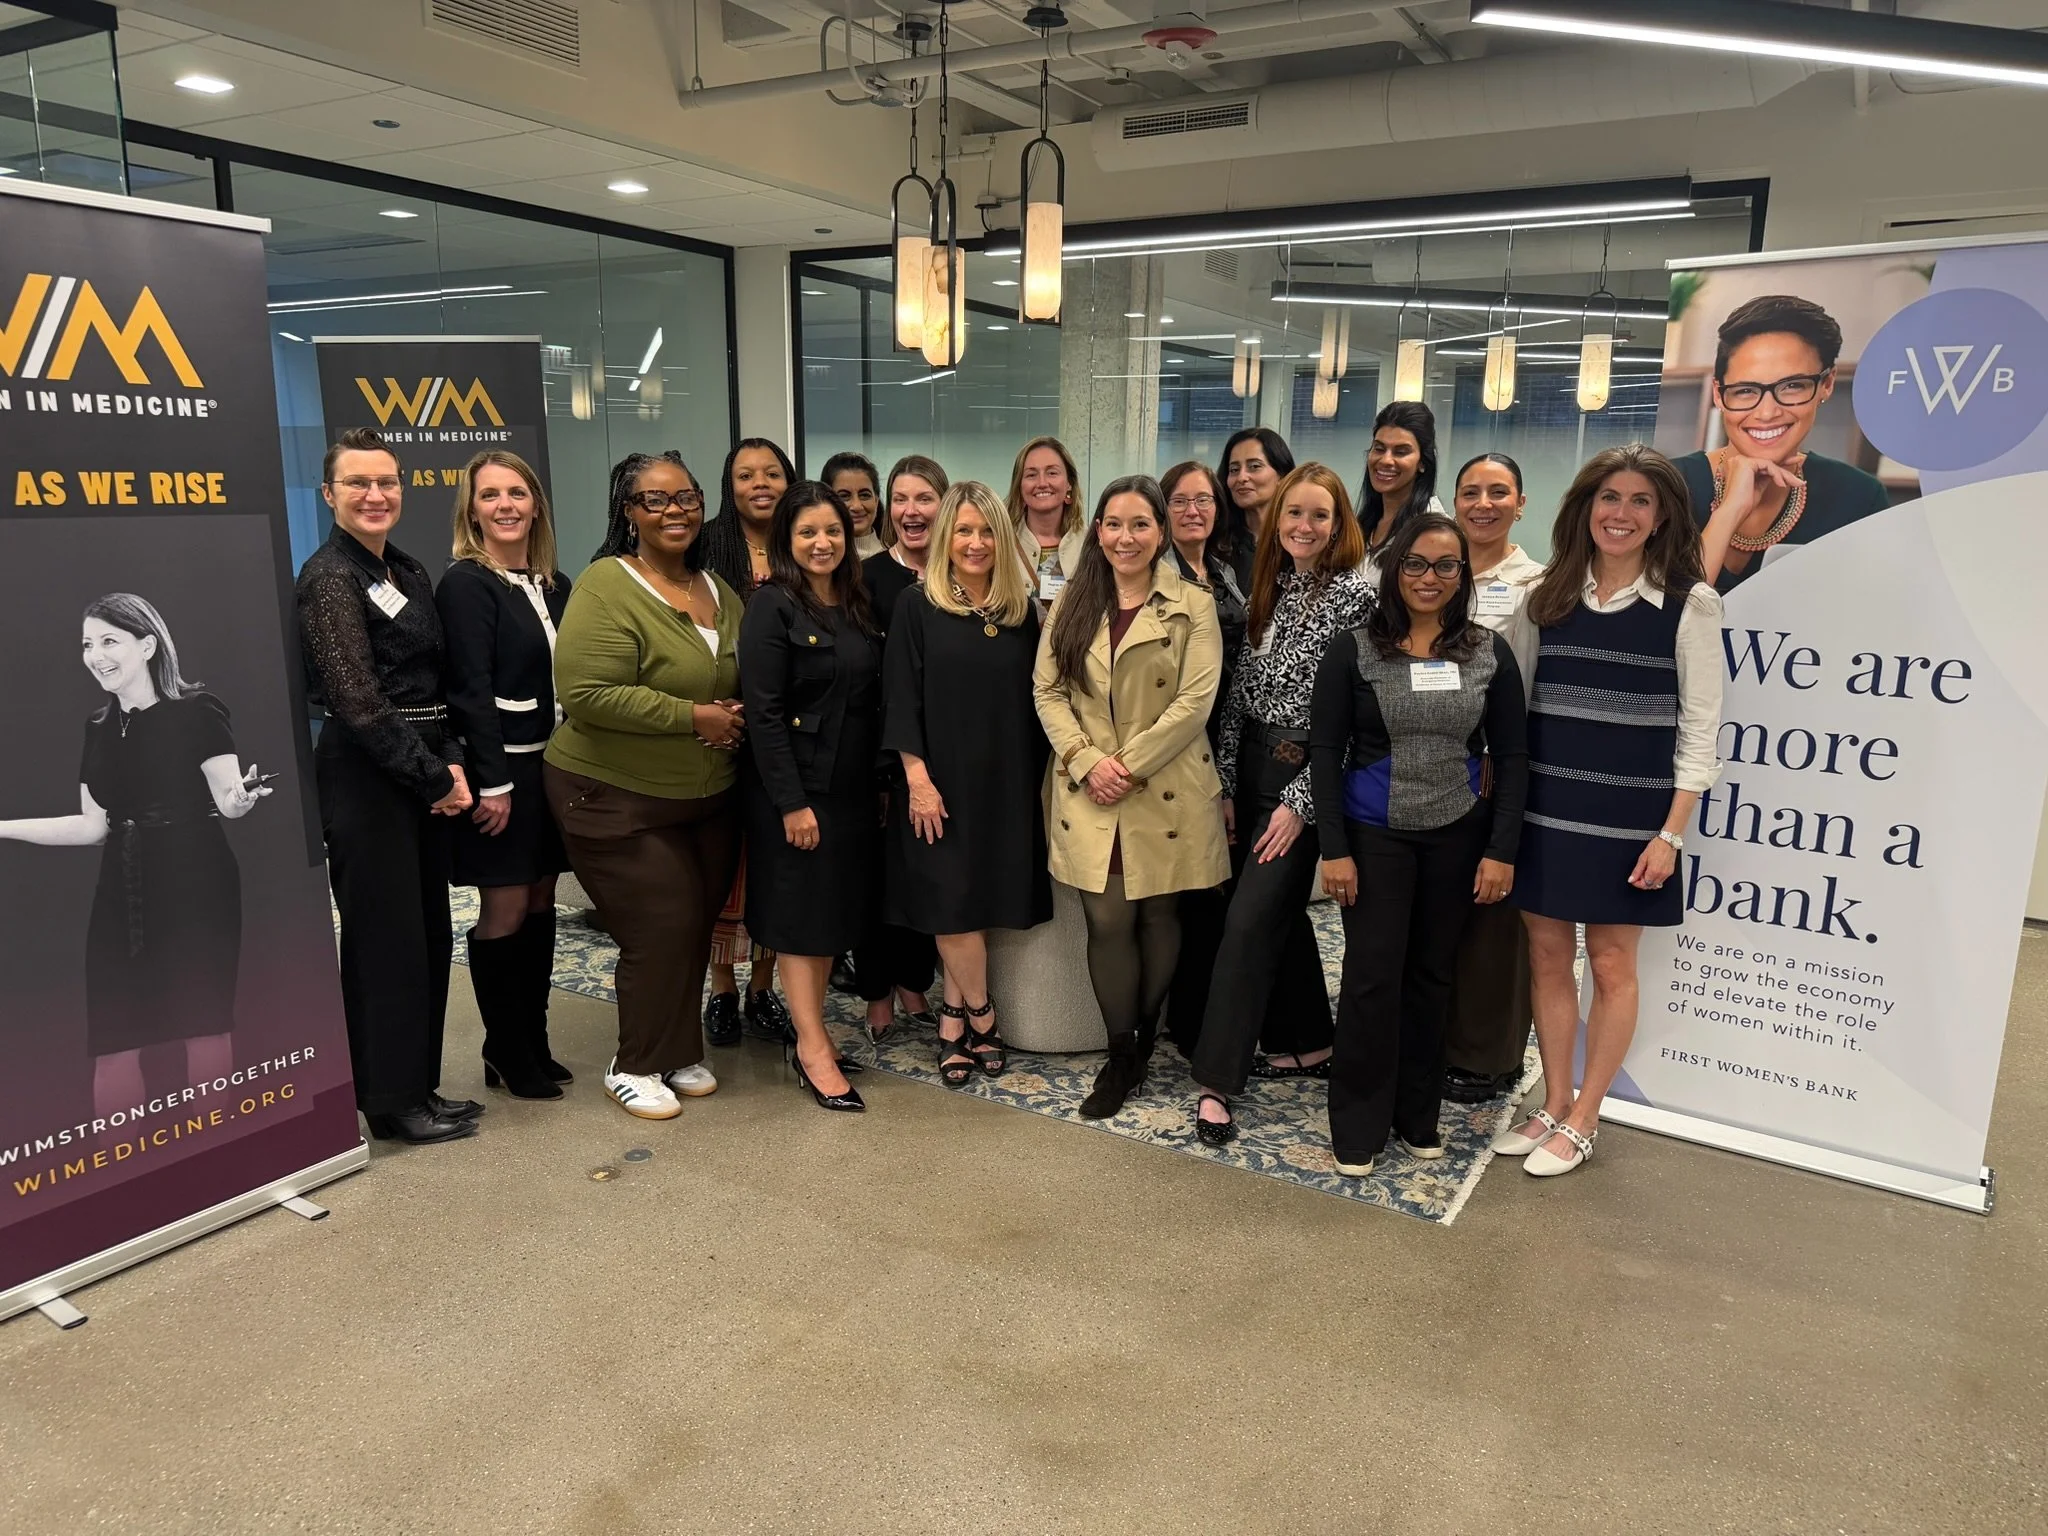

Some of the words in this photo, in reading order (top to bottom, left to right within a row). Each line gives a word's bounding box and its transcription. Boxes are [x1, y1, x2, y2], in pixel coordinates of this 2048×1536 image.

[26, 390, 58, 412] IN
[379, 432, 413, 443] MEN
[419, 432, 434, 443] IN
[15, 471, 67, 506] AS
[78, 471, 139, 505] WE
[150, 472, 227, 505] RISE
[412, 469, 436, 487] AS
[1721, 627, 1821, 690] We
[1845, 651, 1973, 704] are
[1715, 720, 1899, 782] more
[1698, 781, 1857, 860] than
[1882, 823, 1925, 870] a
[1685, 854, 1879, 945] bank.
[1673, 957, 1693, 972] to
[1699, 963, 1750, 983] grow
[1757, 972, 1790, 991] the
[1797, 983, 1896, 1016] economy
[1676, 933, 1707, 953] We
[1714, 944, 1745, 960] are
[1752, 951, 1778, 966] on
[1785, 958, 1797, 970] a
[1804, 961, 1885, 987] mission
[1667, 999, 1689, 1015] of
[1693, 1005, 1765, 1031] women
[1772, 1022, 1835, 1047] within
[1842, 1033, 1864, 1053] it.
[1670, 979, 1707, 997] and
[1713, 986, 1788, 1013] elevate
[1795, 1001, 1829, 1022] the
[1836, 1013, 1879, 1032] role
[1660, 1047, 1712, 1069] FIRST
[1717, 1059, 1801, 1089] WOMEN'S
[1805, 1079, 1860, 1102] BANK
[0, 1046, 316, 1167] WIMSTRONGERTOGETHER
[13, 1083, 297, 1197] WIMEDICINE.ORG
